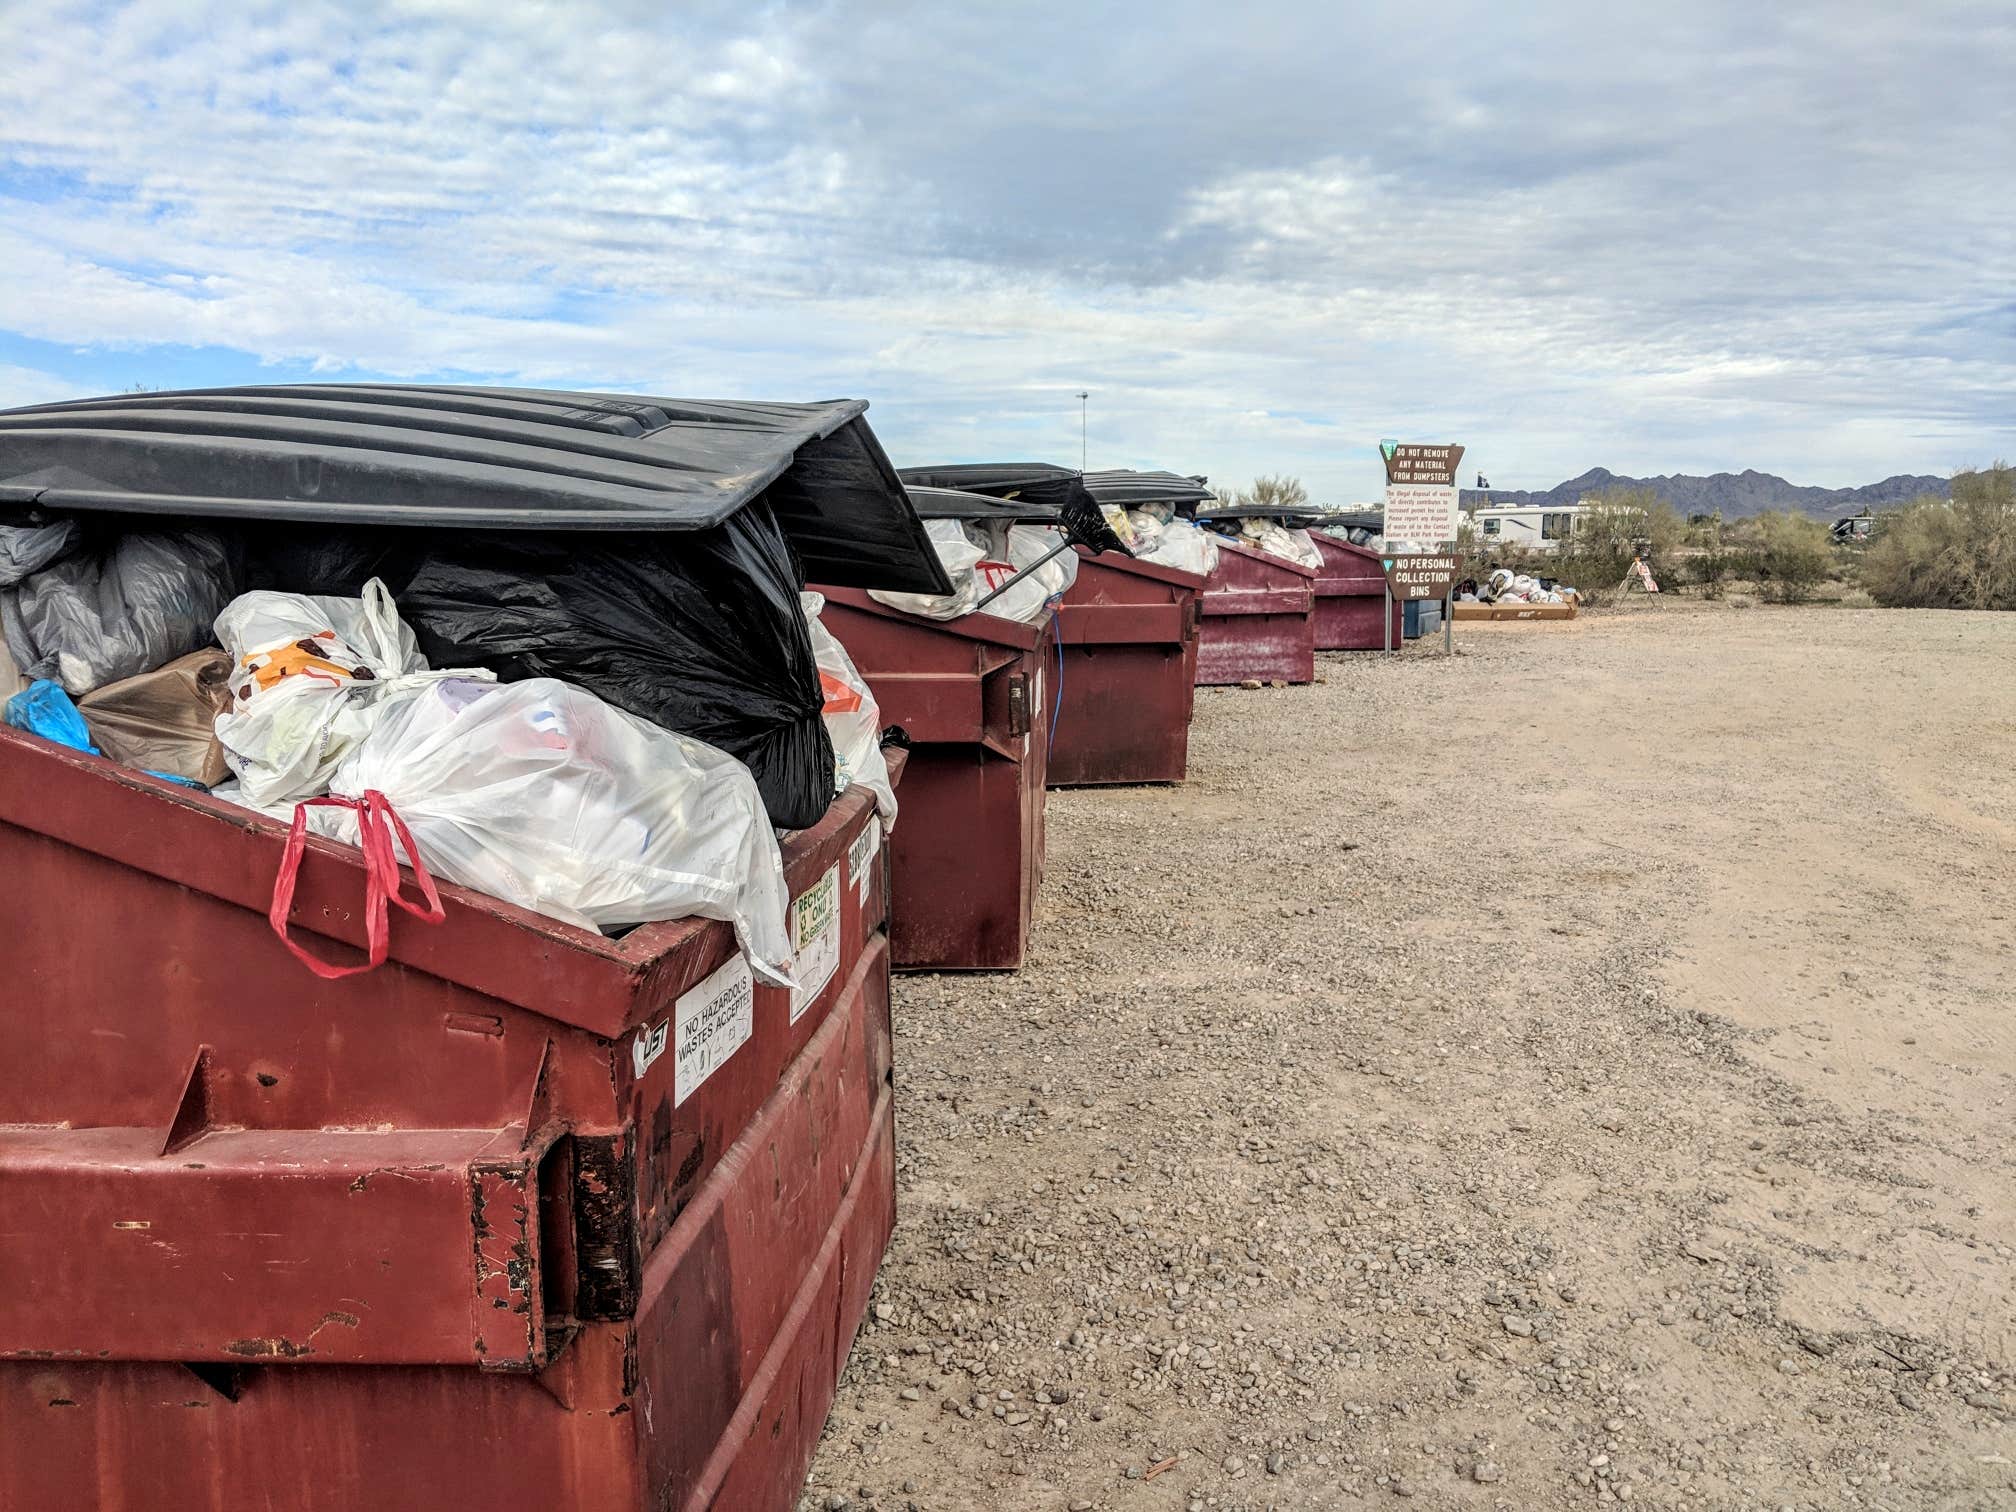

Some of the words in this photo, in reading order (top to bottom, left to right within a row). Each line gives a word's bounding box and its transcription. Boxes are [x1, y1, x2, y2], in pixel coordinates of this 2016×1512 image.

[1397, 448, 1405, 456] DO
[1409, 448, 1420, 456] NOT
[1424, 449, 1449, 458] REMOVE
[1399, 460, 1412, 468] ANY
[1415, 460, 1446, 469] MATERIAL
[1394, 472, 1410, 480] FROM
[1414, 472, 1450, 481] DUMPSTERS
[1397, 559, 1408, 569] NO
[1410, 558, 1456, 569] PERSONAL
[1396, 572, 1450, 583] COLLECTION
[1410, 586, 1430, 597] BINS
[685, 1017, 699, 1038] NO
[702, 976, 747, 1024] HAZARDOUS
[678, 1023, 713, 1063] WASTES
